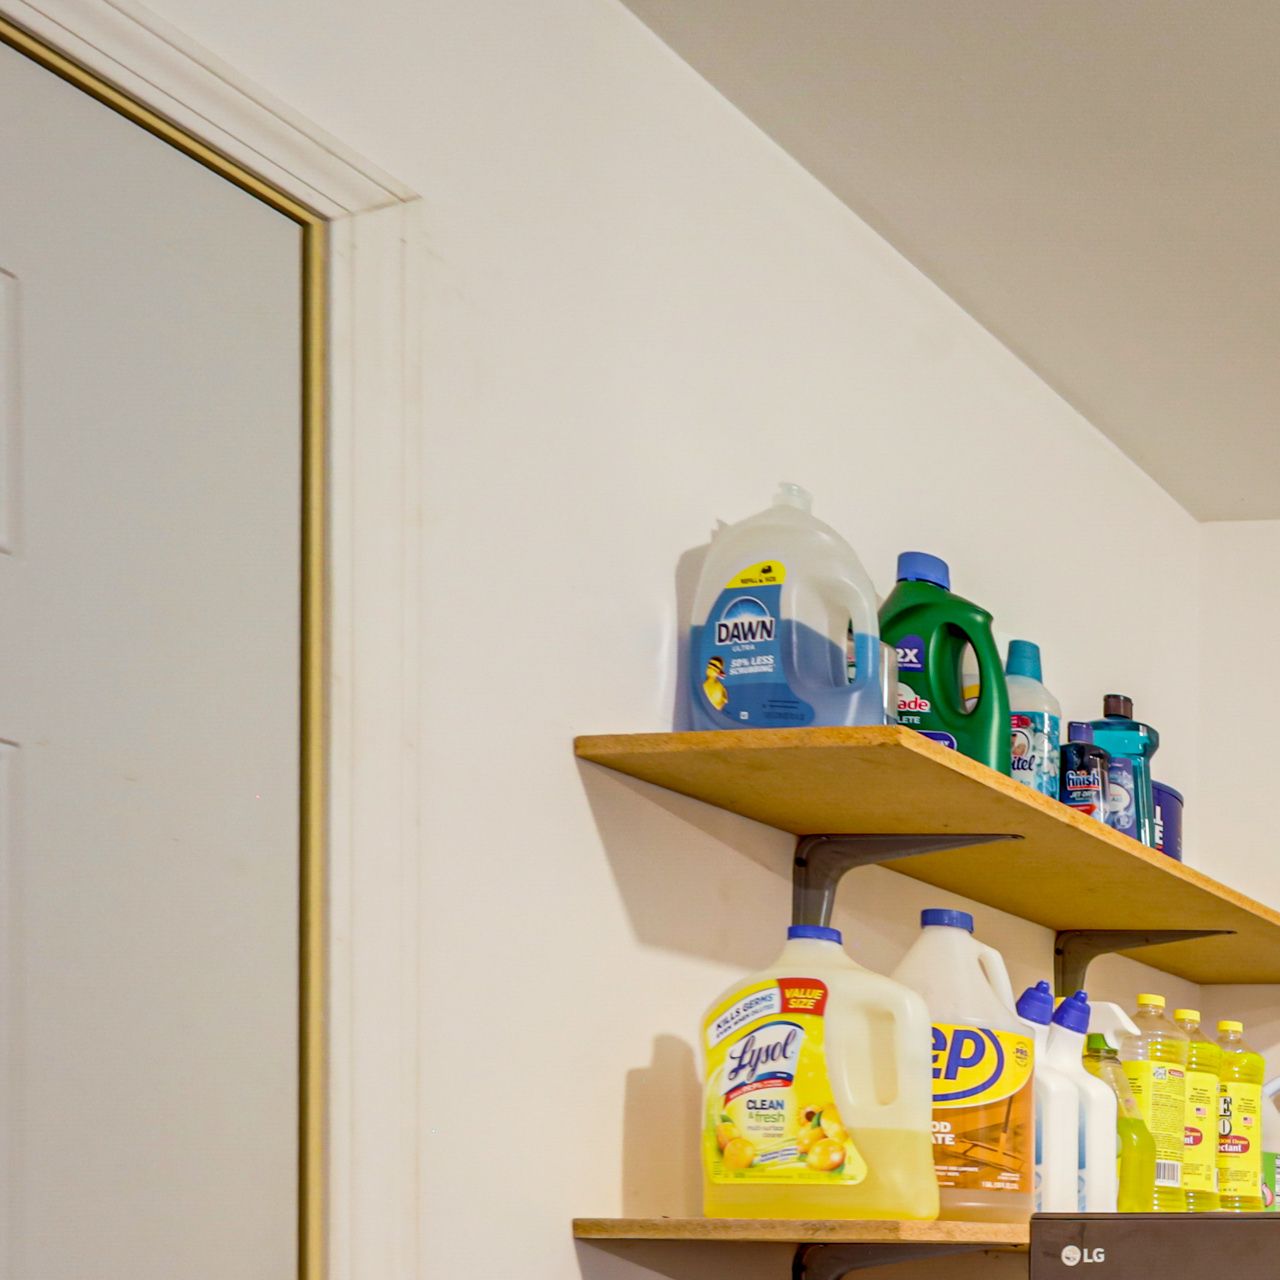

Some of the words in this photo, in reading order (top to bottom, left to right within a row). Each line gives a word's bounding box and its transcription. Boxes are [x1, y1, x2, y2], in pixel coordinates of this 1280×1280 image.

[717, 619, 774, 644] DAWN
[730, 658, 750, 668] 50%
[751, 655, 775, 665] LESS
[896, 648, 919, 663] 2X
[729, 665, 775, 676] SCRUBBING
[1067, 770, 1101, 786] finish
[784, 988, 825, 1000] VALUE
[787, 999, 817, 1009] SIZE
[716, 1008, 741, 1031] KILLS
[743, 992, 775, 1012] GERMS
[728, 1029, 797, 1081] Lysol
[746, 1099, 785, 1110] CLEAN
[755, 1111, 786, 1123] fresh
[1083, 1247, 1105, 1263] LG
